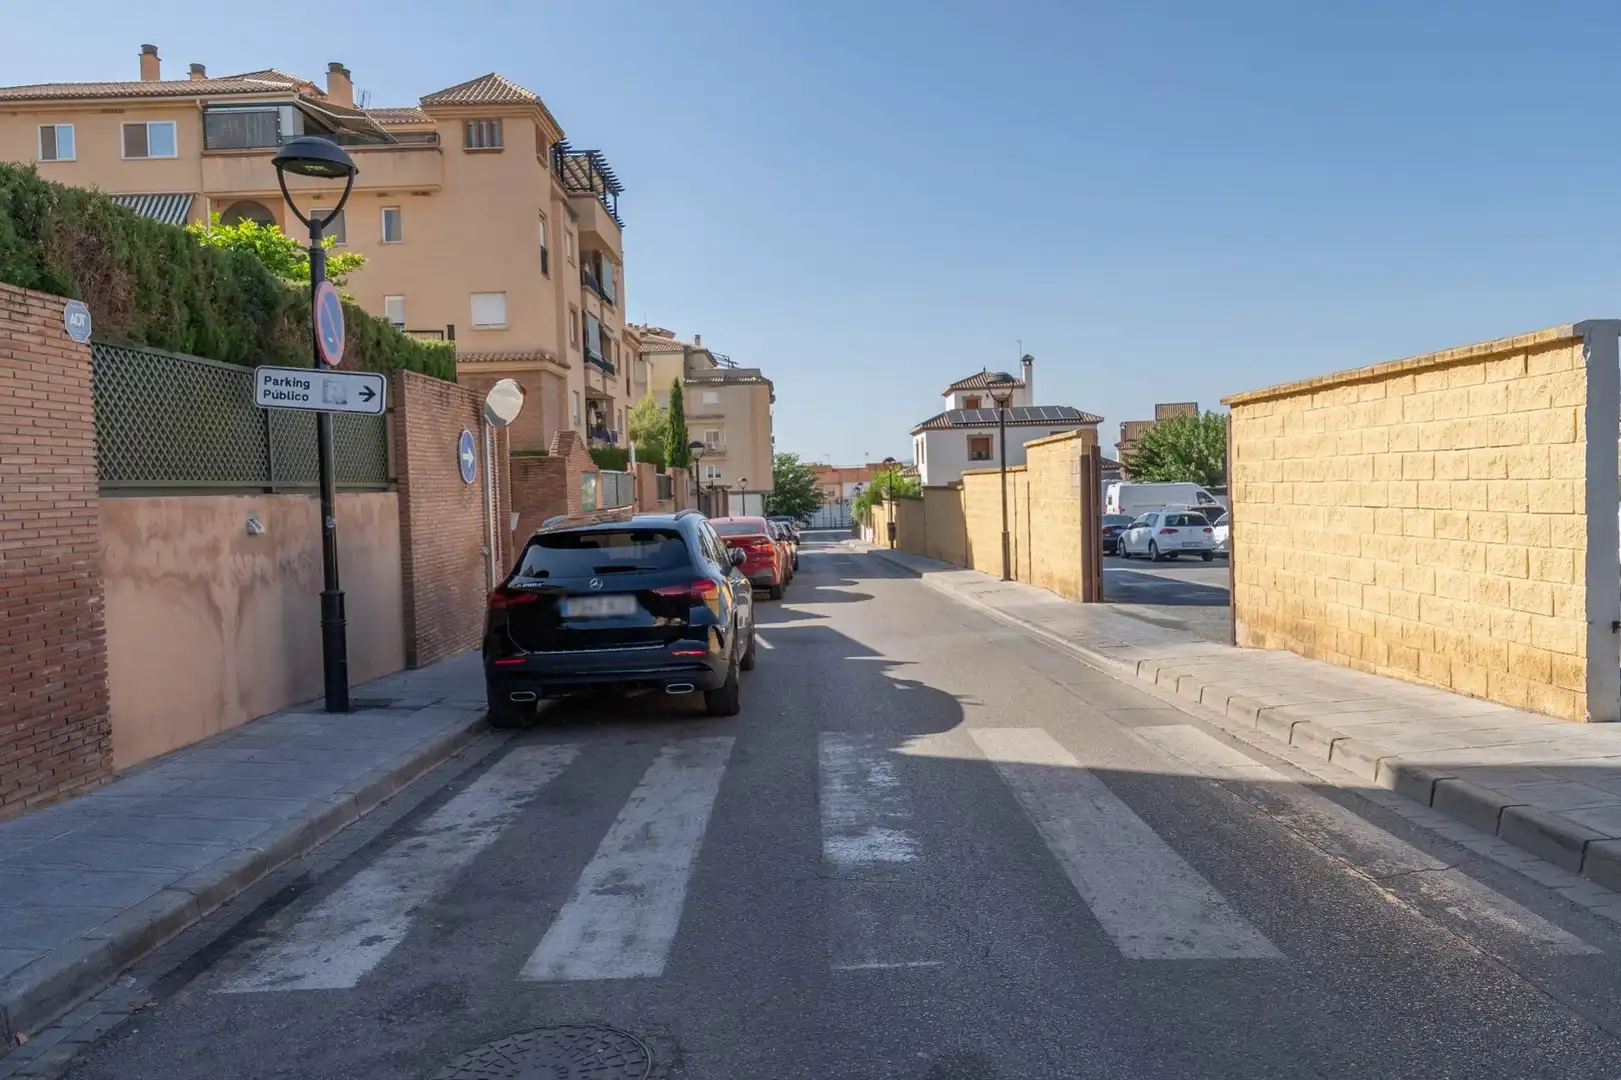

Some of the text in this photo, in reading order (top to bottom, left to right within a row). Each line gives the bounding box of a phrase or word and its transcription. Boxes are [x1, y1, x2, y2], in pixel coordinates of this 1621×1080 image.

[70, 313, 87, 328] ADT
[264, 376, 310, 390] Parking
[264, 389, 309, 402] Público
